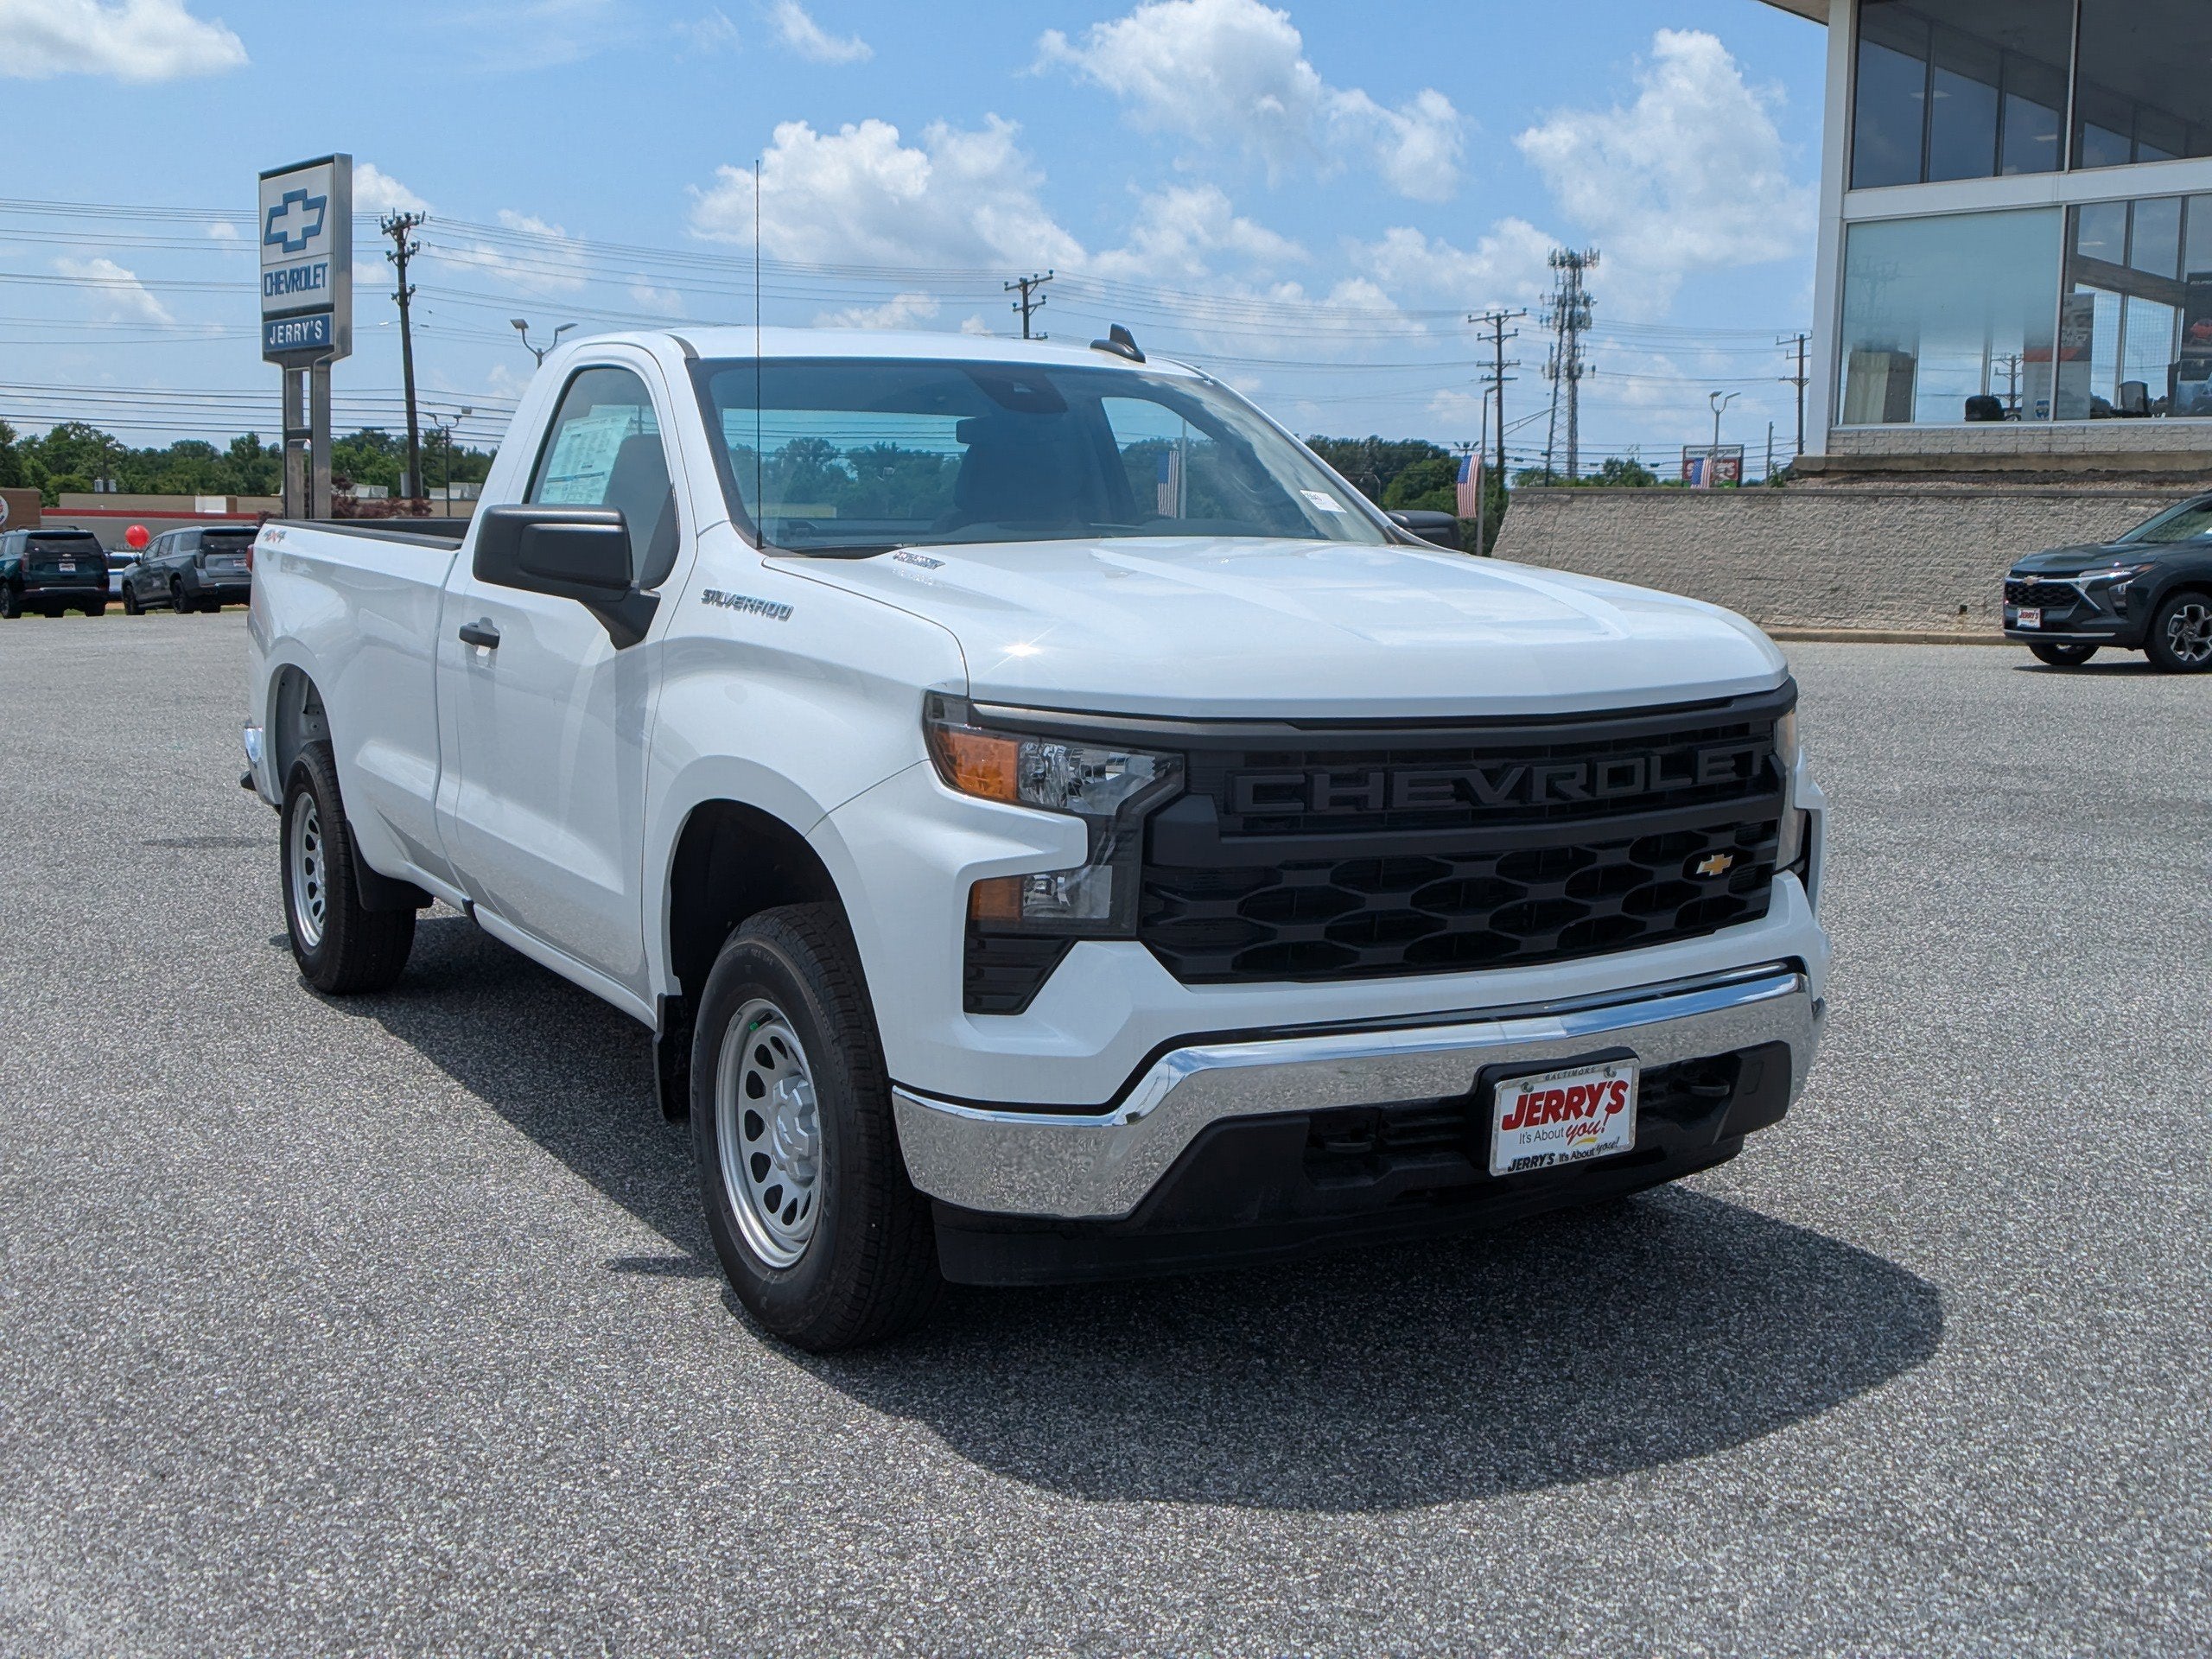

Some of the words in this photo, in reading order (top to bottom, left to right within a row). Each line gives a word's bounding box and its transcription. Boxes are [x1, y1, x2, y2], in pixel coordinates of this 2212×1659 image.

[264, 263, 328, 296] CHEVROLET
[270, 320, 323, 345] JERRY'S
[701, 588, 794, 621] SILVERADO
[1234, 741, 1772, 813] CHEVROLET
[1544, 1066, 1597, 1082] BALTIMORE
[1501, 1080, 1630, 1131] JERRY'S
[1519, 1131, 1532, 1145] It's
[1534, 1127, 1564, 1142] About
[1565, 1113, 1609, 1146] you!
[1507, 1152, 1556, 1173] JERRY'S
[1558, 1152, 1570, 1163] It's
[1570, 1147, 1596, 1161] About
[1595, 1136, 1620, 1155] you!
